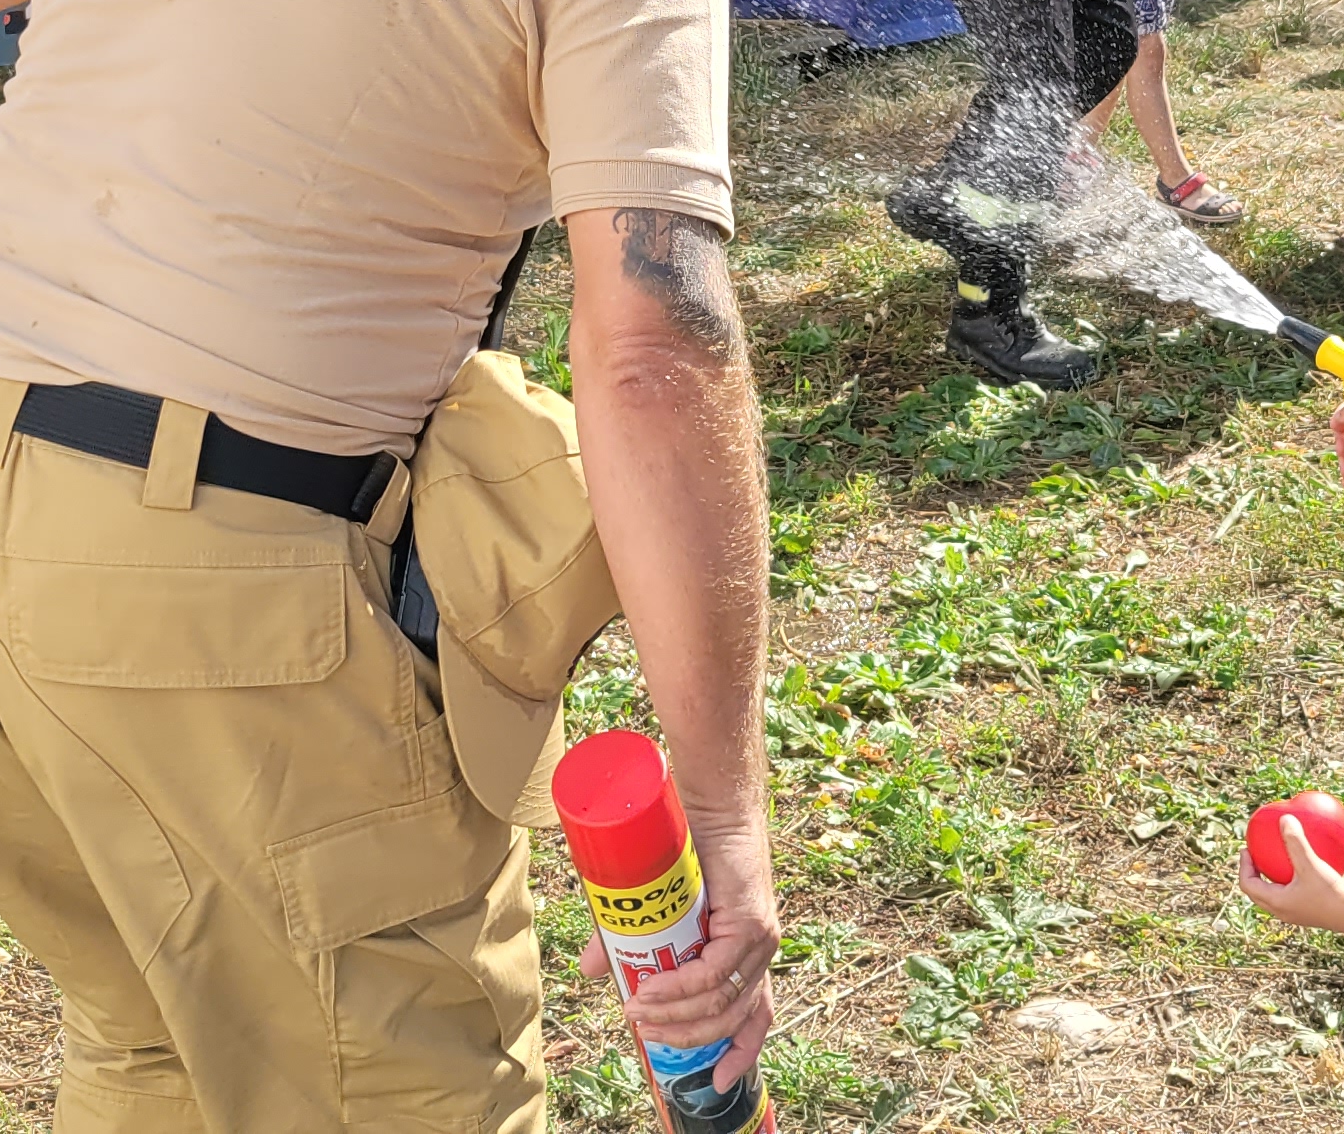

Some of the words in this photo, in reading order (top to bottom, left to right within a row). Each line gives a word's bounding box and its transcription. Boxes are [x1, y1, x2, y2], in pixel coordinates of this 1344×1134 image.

[593, 876, 685, 912] 10%
[600, 890, 689, 927] GRATIS
[615, 947, 649, 960] new
